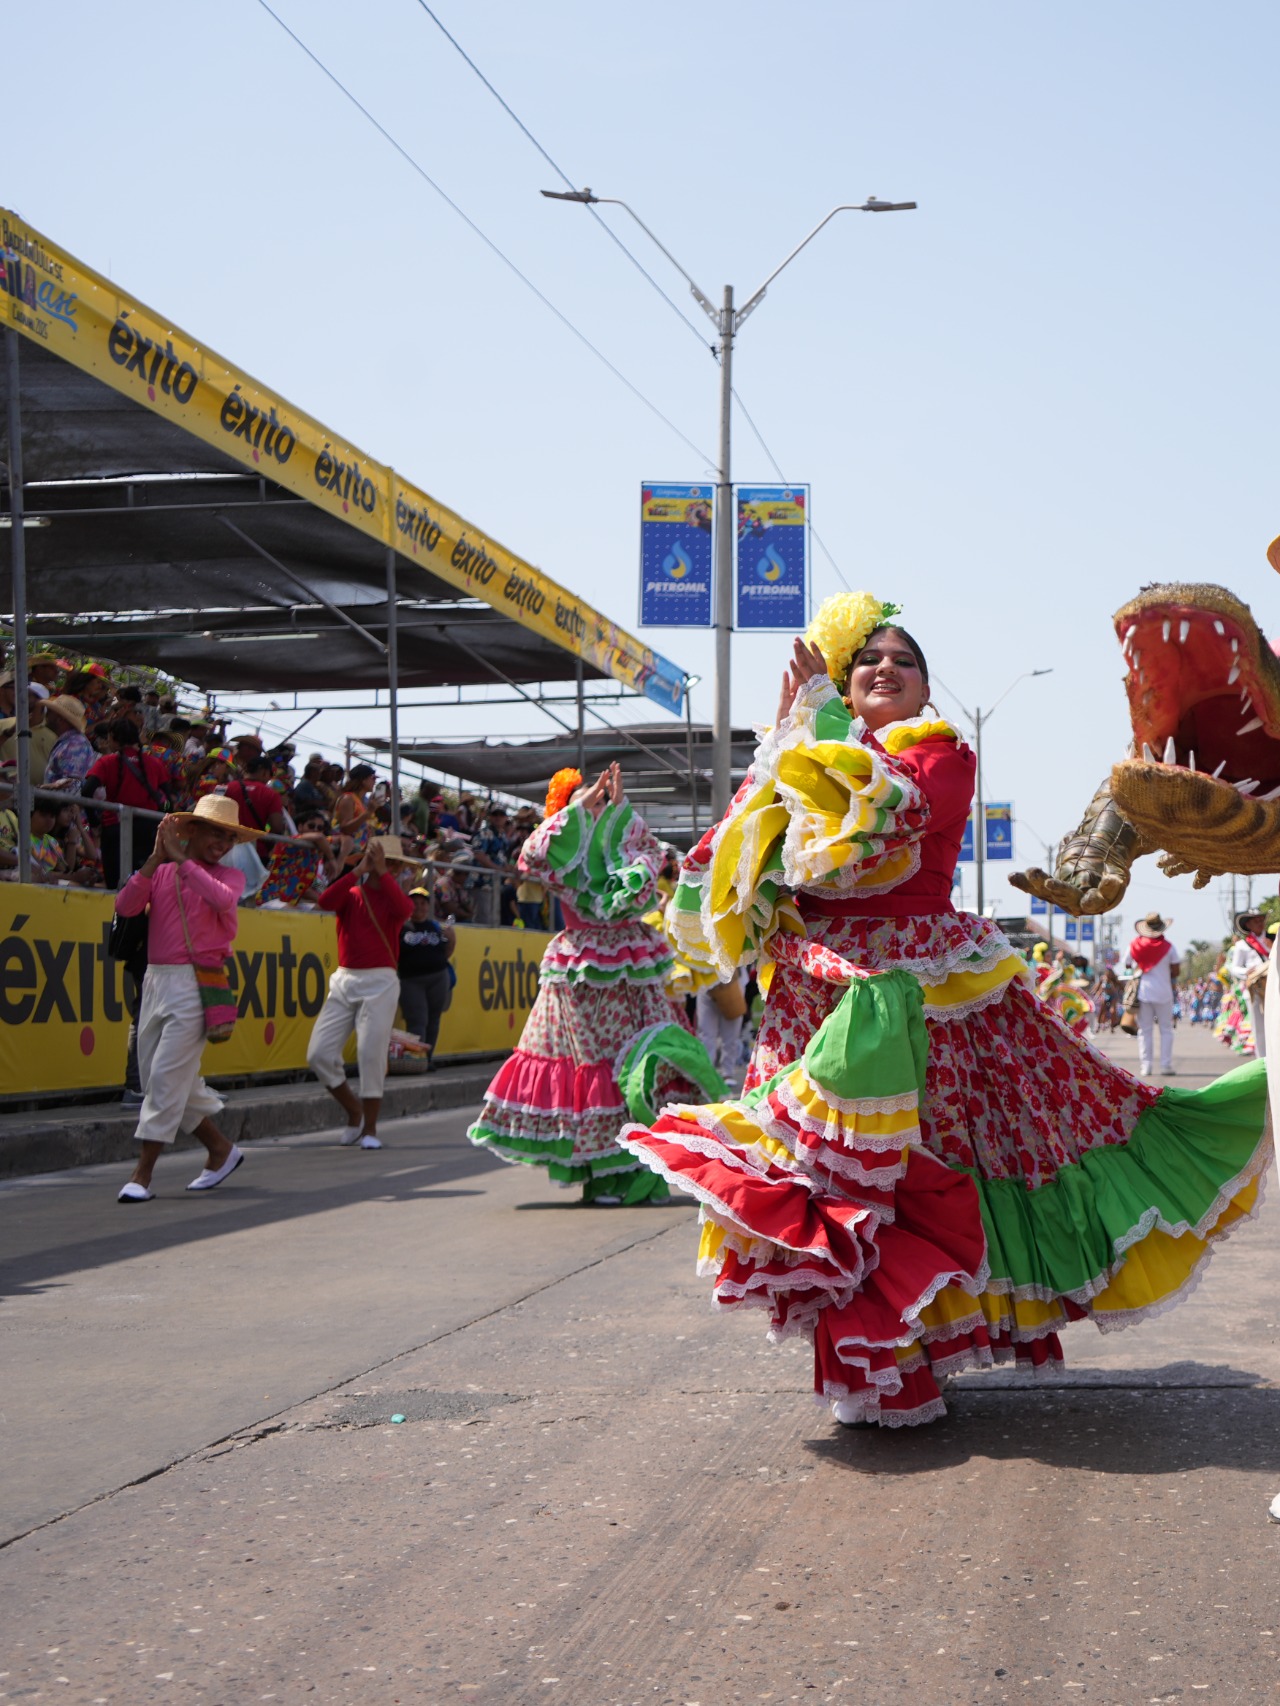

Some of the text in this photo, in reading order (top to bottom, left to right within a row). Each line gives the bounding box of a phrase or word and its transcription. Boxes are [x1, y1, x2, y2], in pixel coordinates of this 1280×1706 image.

[107, 311, 377, 514] éxito éxito éxito
[395, 492, 442, 555] éxito
[450, 532, 498, 588] éxito
[503, 567, 547, 618] éxito
[646, 582, 707, 594] PETROMIL
[741, 585, 801, 596] PETROMIL
